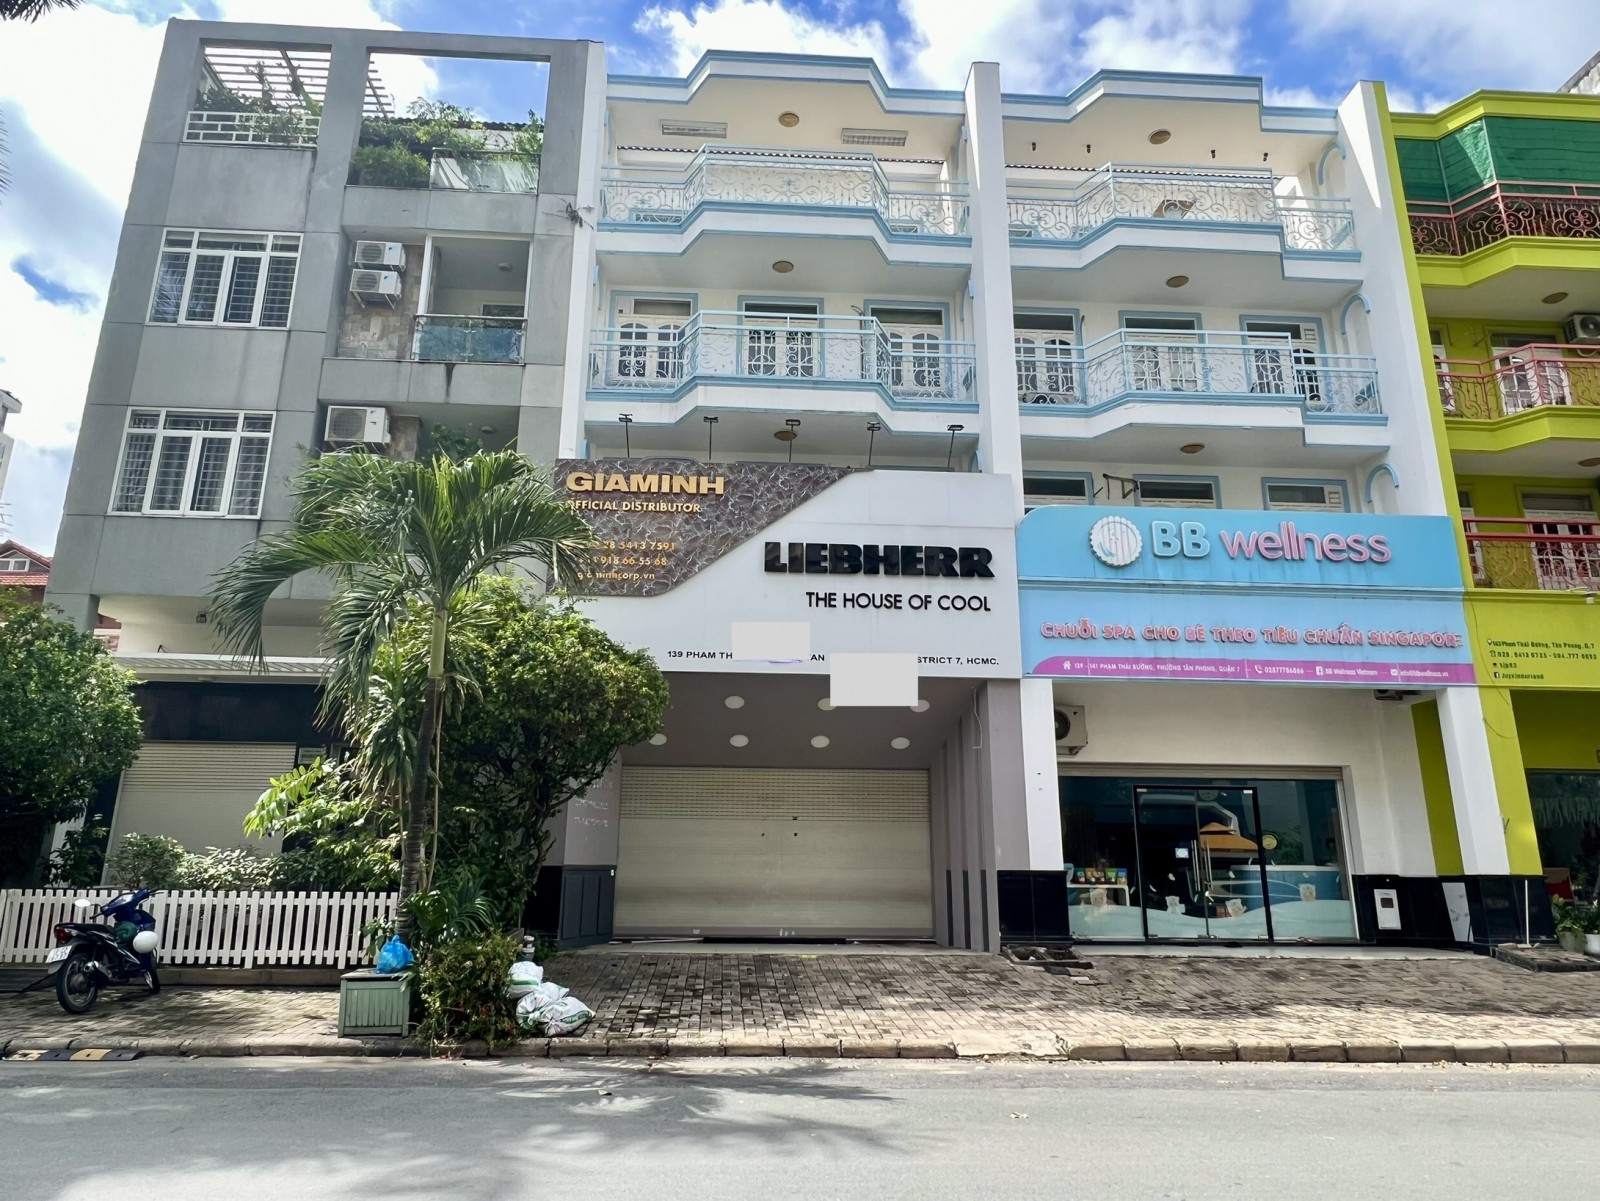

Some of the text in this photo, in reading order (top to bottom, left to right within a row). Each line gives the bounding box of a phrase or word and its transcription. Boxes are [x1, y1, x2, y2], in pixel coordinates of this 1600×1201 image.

[566, 472, 725, 496] GIAMINH
[567, 499, 702, 513] OFFICIAL DISTRIBUTOR
[619, 541, 647, 550] 5413
[1152, 519, 1392, 564] BB wellness
[622, 557, 636, 566] 66
[639, 557, 651, 566] 55
[654, 558, 667, 566] 68
[764, 542, 996, 578] LIEBHERR
[806, 591, 991, 612] THE HOUSE OF COOL
[1101, 624, 1136, 641] SPA
[1140, 625, 1181, 643] CHO
[1184, 623, 1207, 643] BÉ
[1210, 626, 1258, 644] THEO
[667, 650, 683, 658] 139
[686, 651, 716, 659] PHAM
[966, 657, 1000, 666] HCMC.
